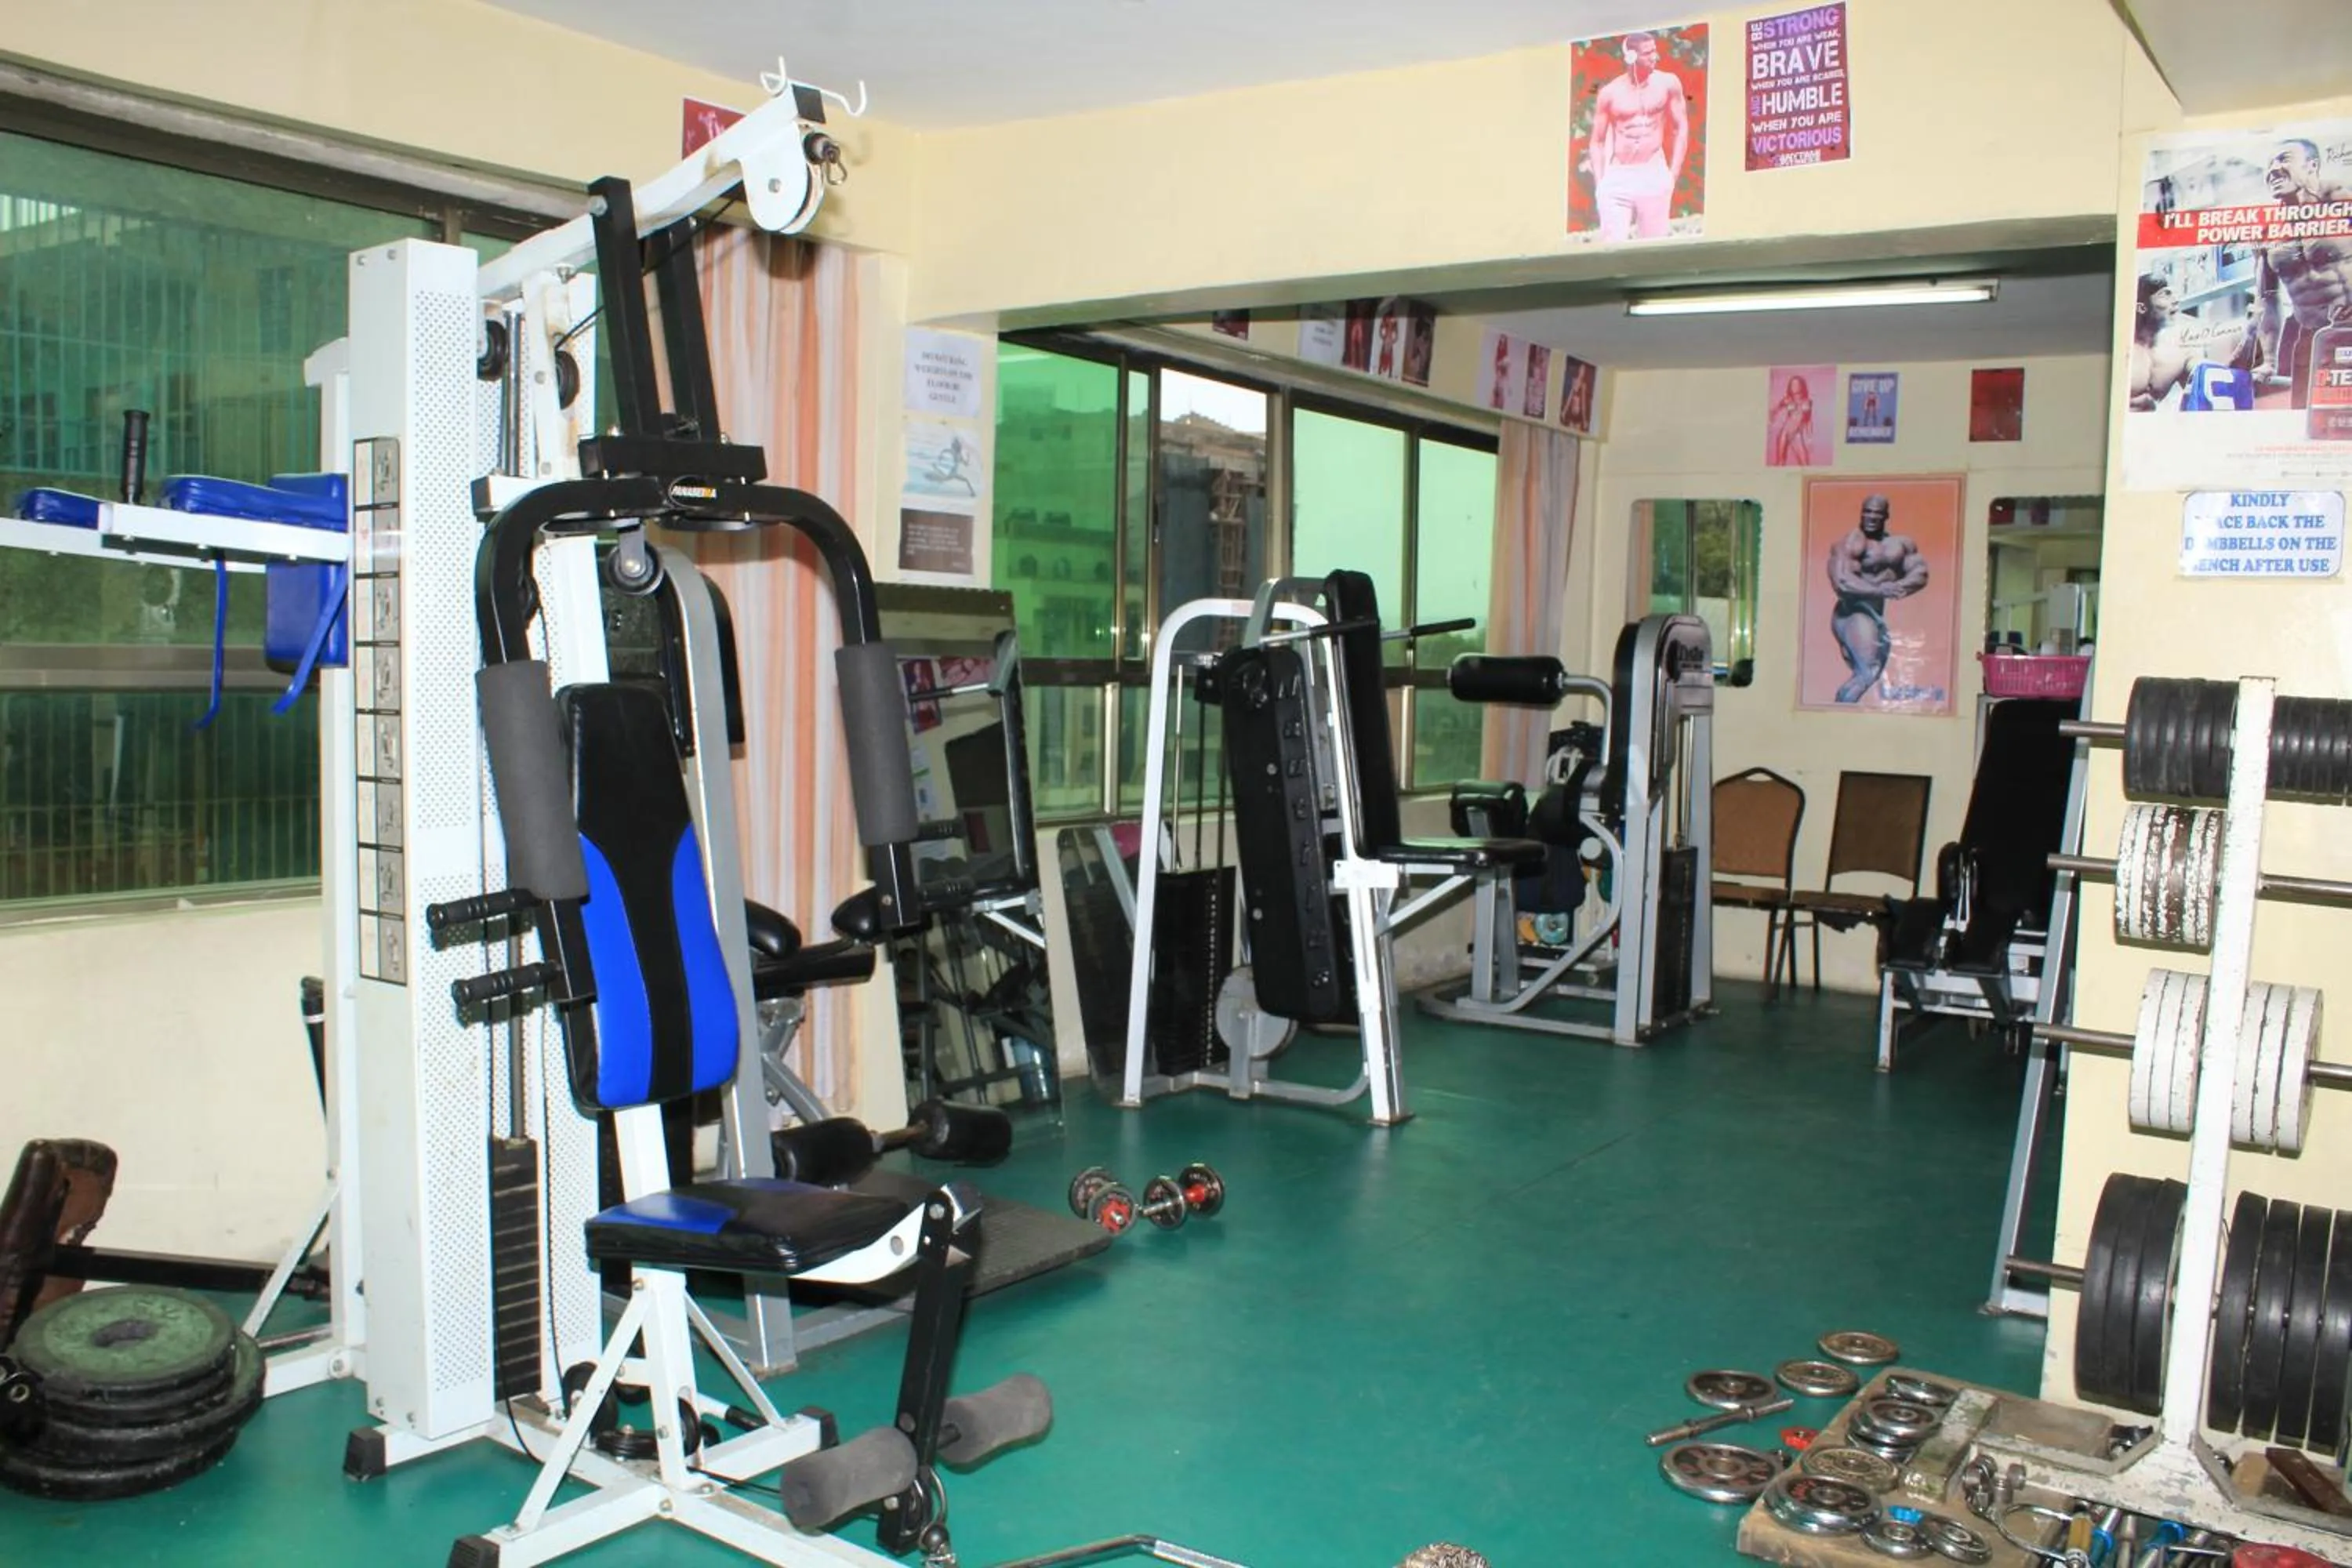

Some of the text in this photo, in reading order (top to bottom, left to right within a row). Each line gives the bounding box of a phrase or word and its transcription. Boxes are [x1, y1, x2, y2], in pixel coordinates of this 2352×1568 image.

[1763, 8, 1839, 38] STRONG
[1779, 37, 1795, 48] YOU
[1796, 34, 1813, 45] ARE
[1752, 40, 1840, 80] BRAVE
[1777, 78, 1793, 87] YOU
[1762, 82, 1843, 115] HUMBLE
[1751, 110, 1842, 134] WHEN YOU ARE
[1751, 125, 1842, 155] VICTORIOUS
[2163, 201, 2352, 230] I'LL BREAK THROUGH
[2197, 225, 2263, 243] POWER
[2230, 493, 2289, 507] KINDLY
[2246, 515, 2289, 528] BACK
[2293, 515, 2325, 528] THE
[2184, 536, 2337, 550] DMBBELLS ON THE
[2193, 557, 2330, 572] ENCH AFTER USE
